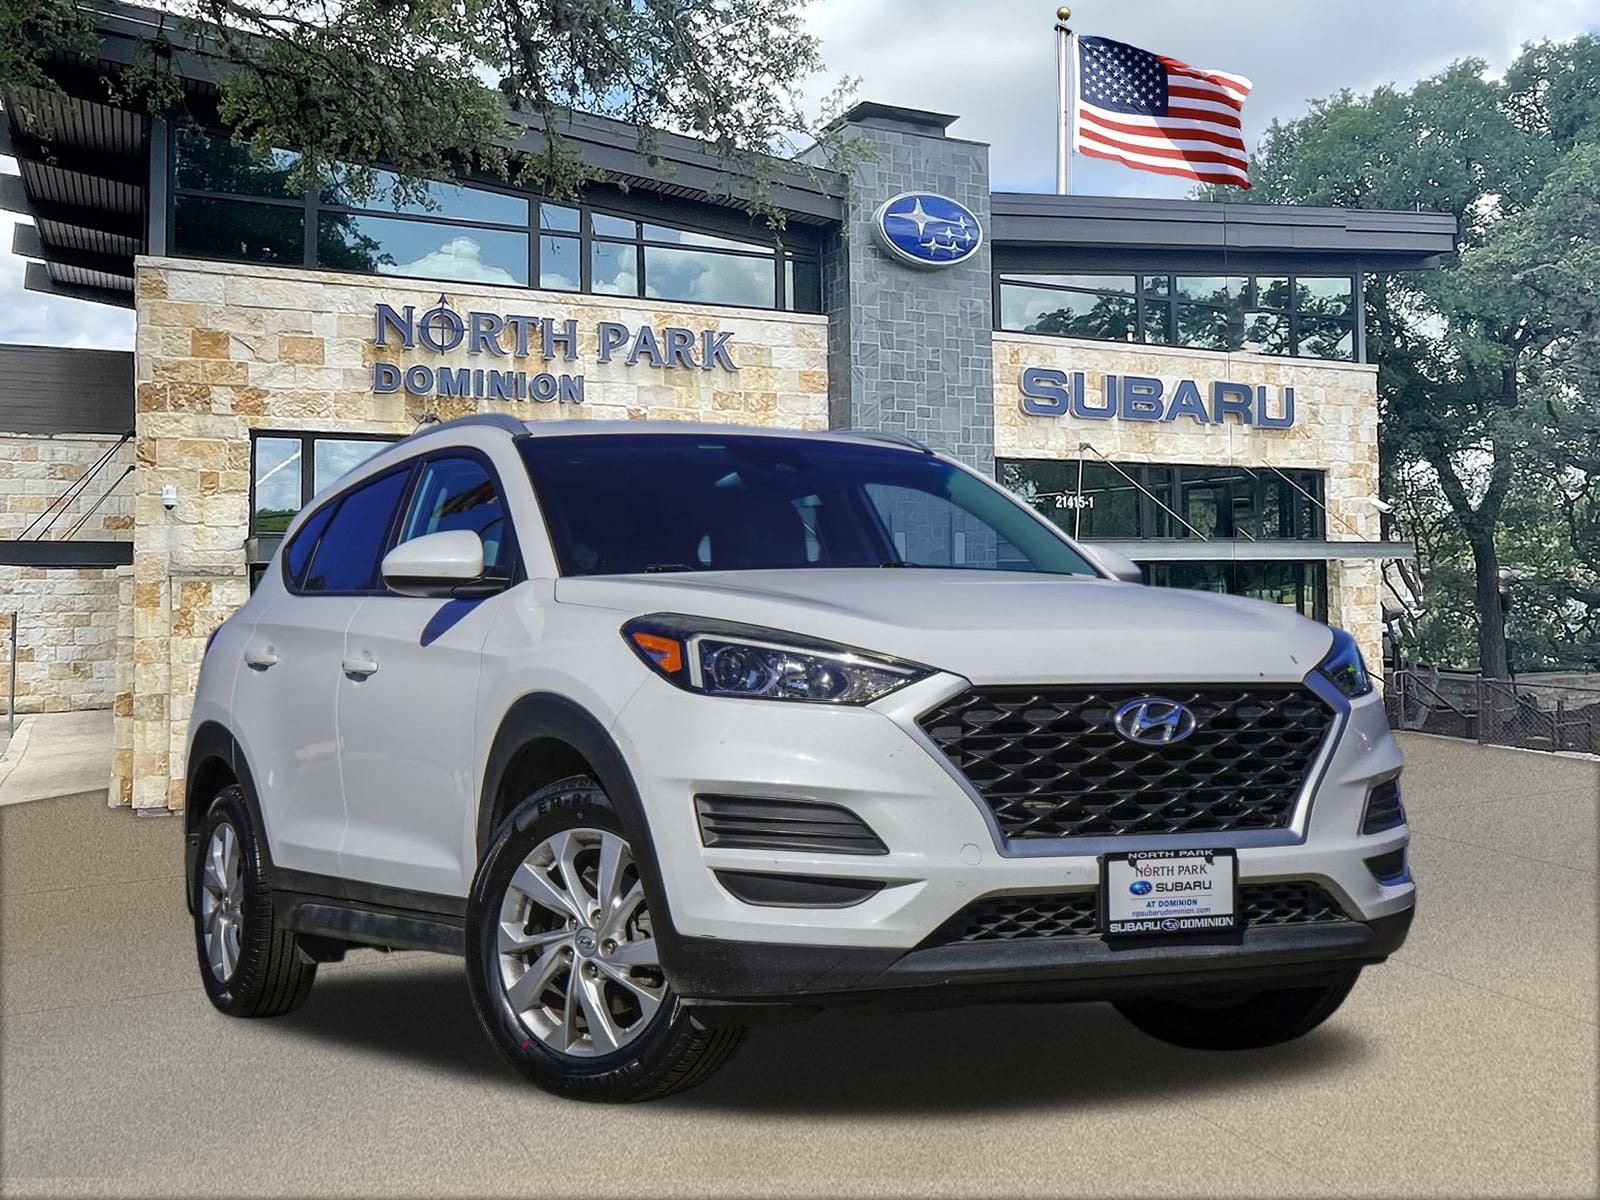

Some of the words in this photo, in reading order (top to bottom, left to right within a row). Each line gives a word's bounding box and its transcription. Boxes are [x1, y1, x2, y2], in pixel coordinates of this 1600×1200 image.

[374, 294, 579, 361] NORTH
[596, 321, 741, 373] PARK
[373, 362, 585, 404] DOMINION
[1019, 367, 1295, 429] SUBARU
[1055, 495, 1094, 509] 21415-1
[1128, 850, 1174, 860] NORTH
[1179, 849, 1214, 857] PARK
[1135, 865, 1174, 877] NORTH
[1178, 864, 1208, 876] PARK
[1155, 881, 1212, 892] SUBARU
[1146, 900, 1156, 908] AT
[1158, 898, 1198, 907] DOMINION
[1131, 907, 1211, 917] npsubarudominion.com
[1109, 921, 1160, 933] SUBARU
[1180, 917, 1234, 929] DOMINION
